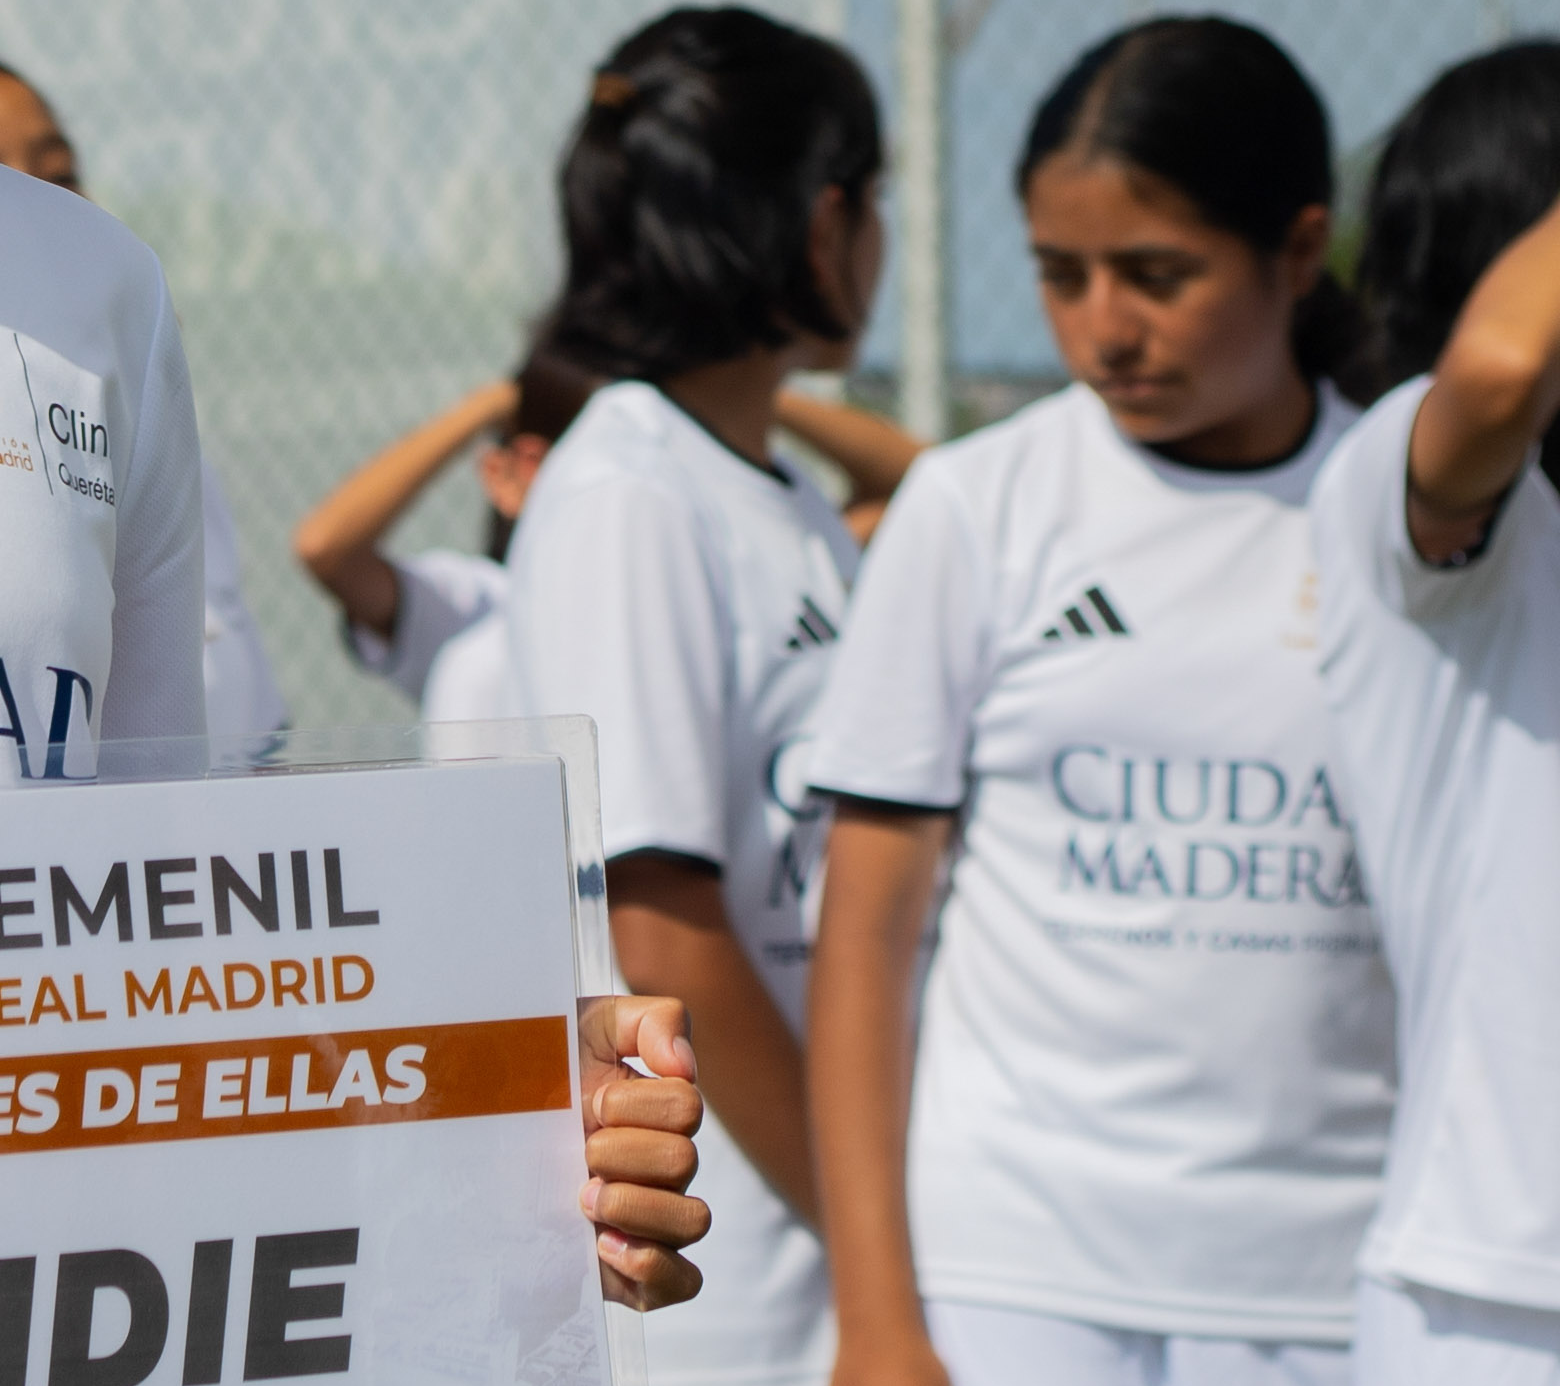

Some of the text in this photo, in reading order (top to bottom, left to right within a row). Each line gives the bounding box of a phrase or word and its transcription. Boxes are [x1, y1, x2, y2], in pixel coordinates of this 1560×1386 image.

[1050, 743, 1346, 827] CIUDA
[123, 953, 377, 1020] MADRID
[80, 1060, 185, 1129] DE
[201, 1043, 429, 1121] ELLAS
